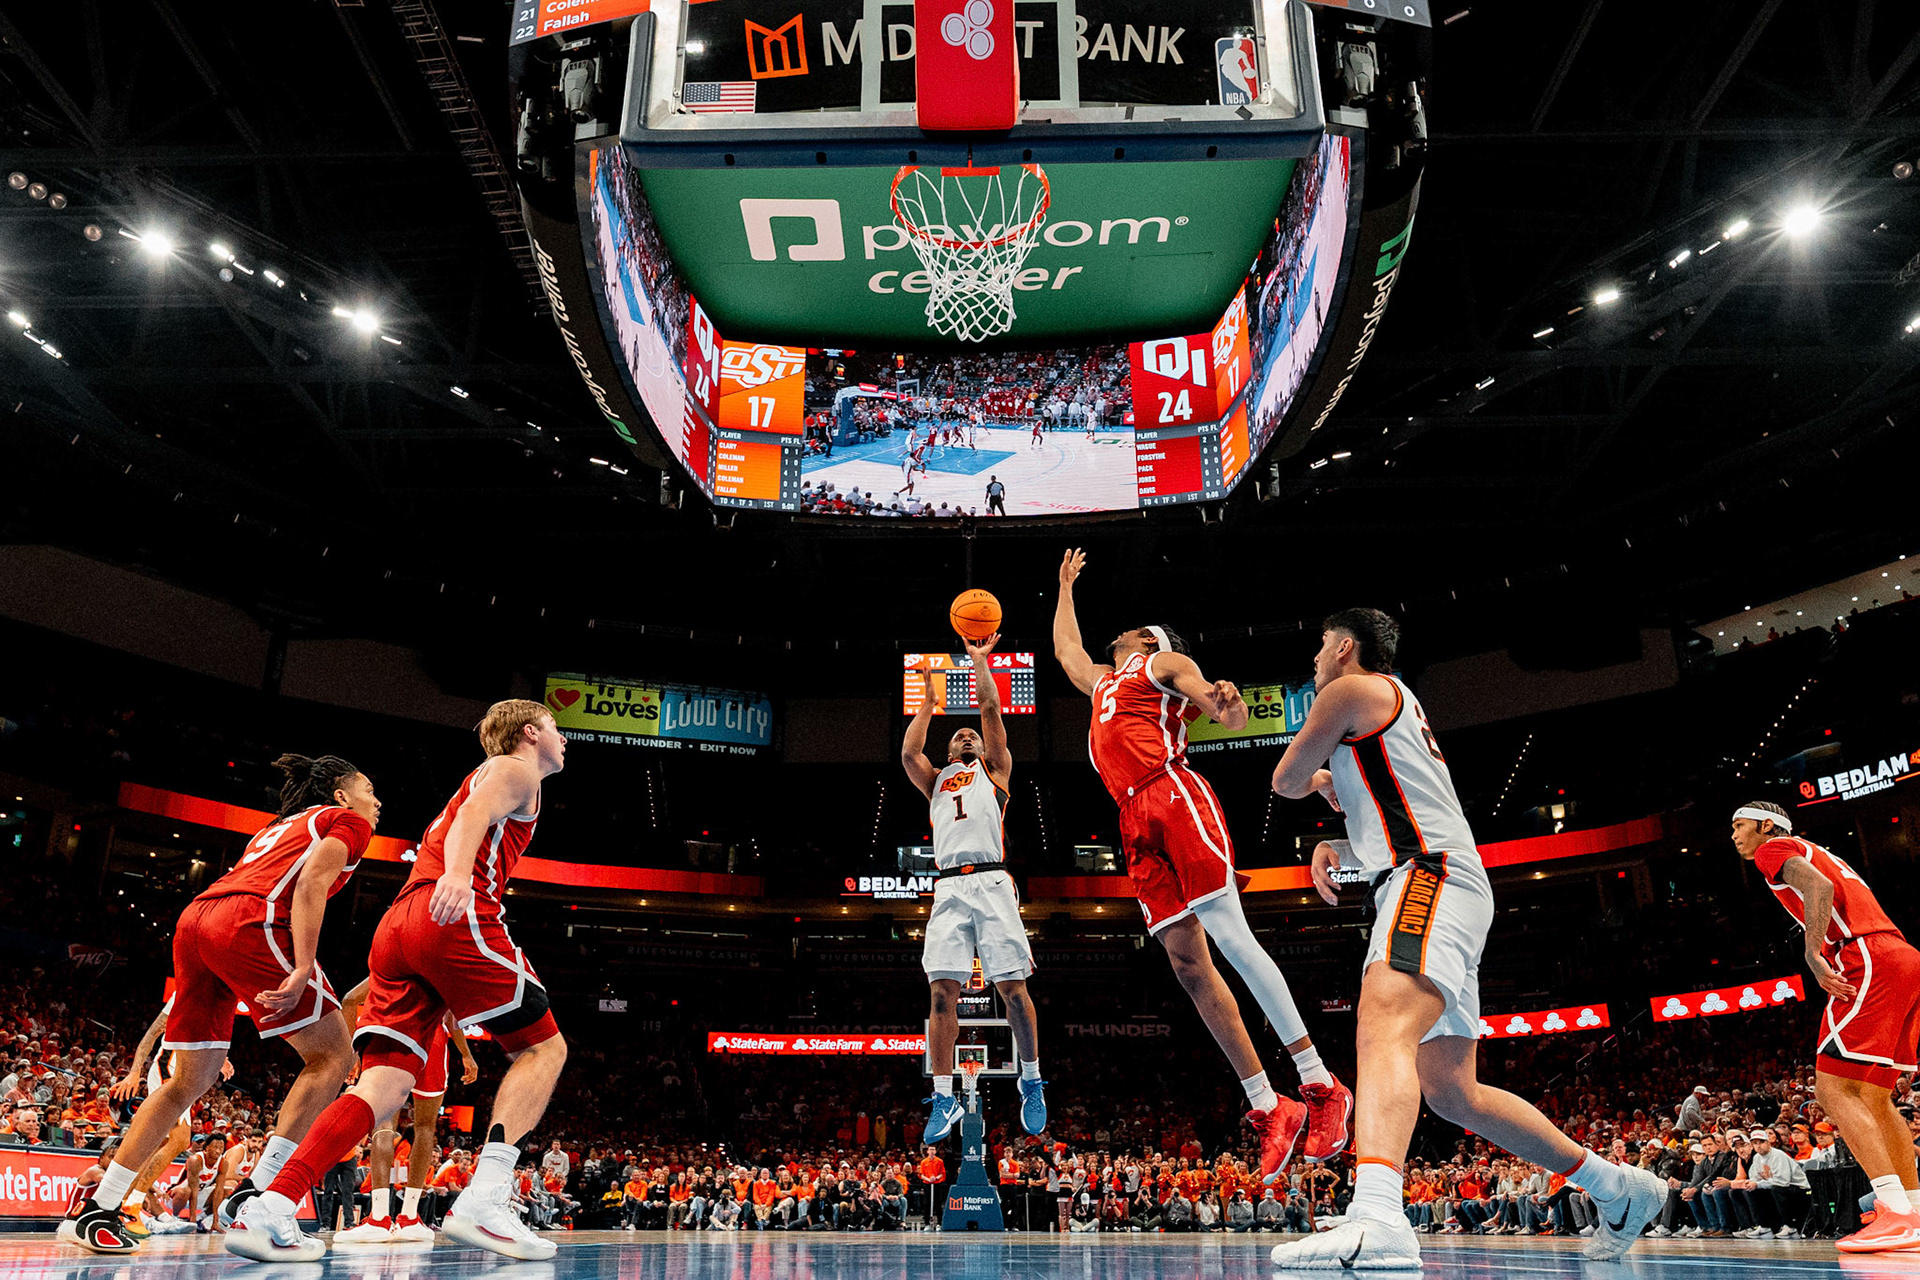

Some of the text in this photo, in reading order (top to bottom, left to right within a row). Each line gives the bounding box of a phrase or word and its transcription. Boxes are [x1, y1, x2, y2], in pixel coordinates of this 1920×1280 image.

[515, 11, 590, 40] 22 Fallah
[519, 9, 535, 22] 21
[1225, 92, 1246, 105] NBA
[532, 238, 570, 323] center
[1347, 267, 1397, 371] paycom
[560, 326, 621, 419] paycom
[695, 363, 710, 408] 24
[1227, 356, 1240, 398] 17
[748, 396, 776, 428] 17
[1157, 389, 1193, 423] 24
[1310, 373, 1354, 431] center
[720, 431, 742, 440] PLAYER
[1136, 432, 1158, 440] PLAYER
[1197, 425, 1209, 433] PTS
[718, 453, 745, 462] COLEMAN
[1187, 493, 1198, 501] 1ST
[928, 657, 944, 668] 17
[993, 656, 1012, 667] 24
[1099, 682, 1119, 724] 5
[1290, 691, 1316, 726] LO
[665, 699, 717, 730] LOUD
[724, 700, 768, 738] CITY
[598, 734, 622, 744] THE
[625, 736, 682, 749] THUNDER
[700, 743, 726, 753] EXIT
[729, 746, 756, 756] NOW
[1187, 736, 1296, 754] BRING THE THUND
[1817, 753, 1910, 797] BEDLAM
[1842, 778, 1895, 801] BASKETBALL
[952, 795, 967, 821] 1
[243, 822, 293, 864] 9
[858, 876, 933, 892] BEDLAM
[1330, 872, 1361, 883] State
[873, 891, 919, 899] BASKETBALL
[1398, 869, 1438, 935] COWBOYS
[1064, 1024, 1172, 1038] THUNDER
[887, 1039, 925, 1051] StateFa
